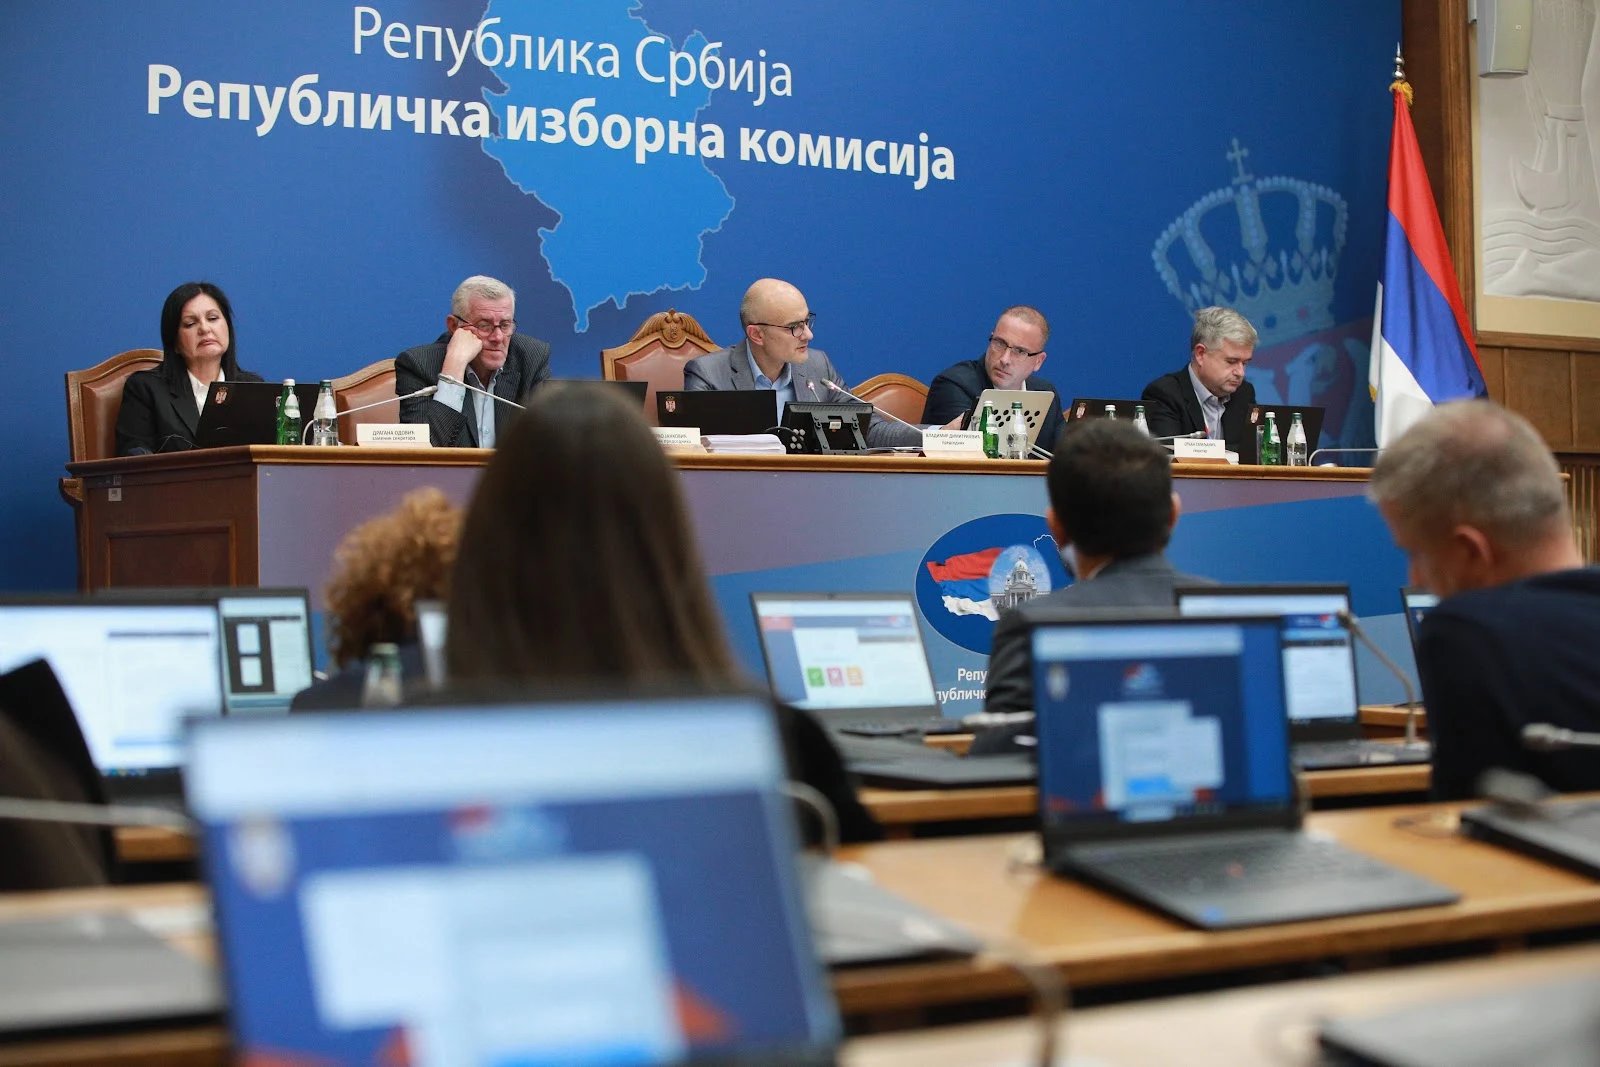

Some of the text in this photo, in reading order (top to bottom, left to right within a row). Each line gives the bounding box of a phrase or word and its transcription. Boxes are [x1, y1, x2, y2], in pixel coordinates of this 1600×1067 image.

[353, 5, 792, 107] Република Србија
[147, 63, 955, 190] Републичка изборна комисија
[936, 687, 987, 704] публичк
